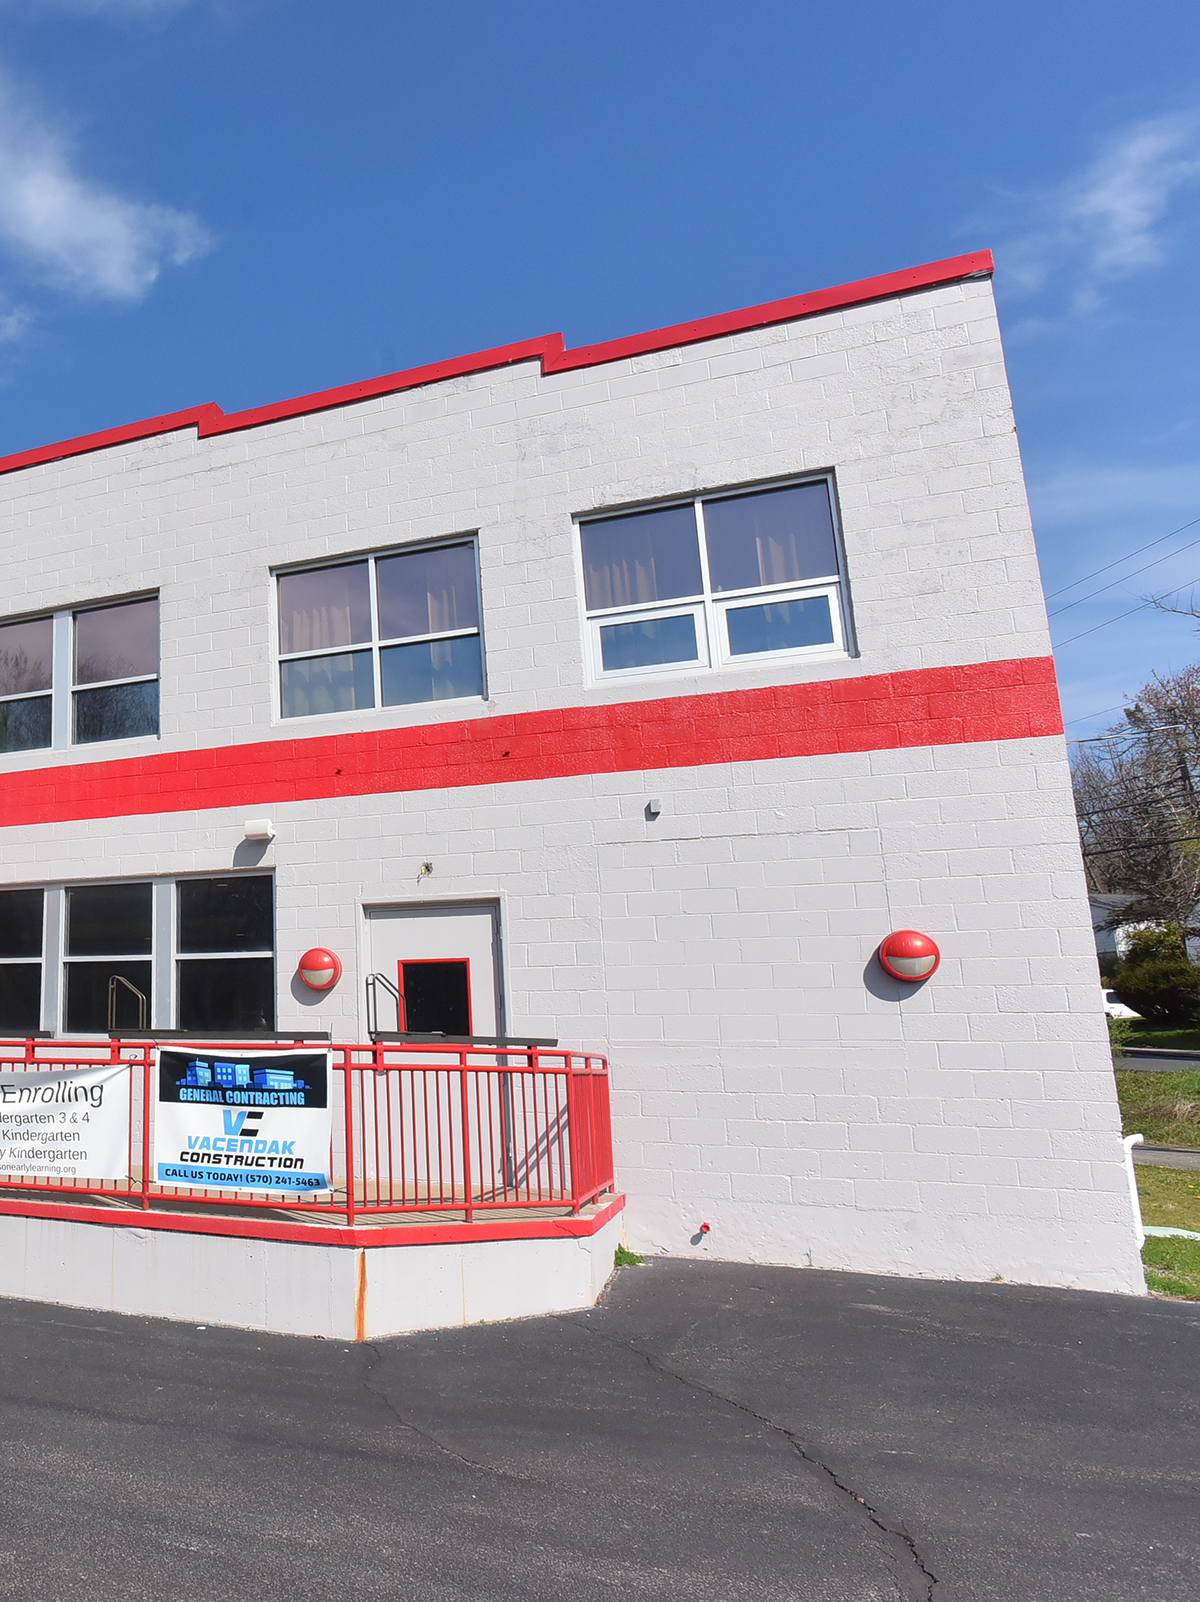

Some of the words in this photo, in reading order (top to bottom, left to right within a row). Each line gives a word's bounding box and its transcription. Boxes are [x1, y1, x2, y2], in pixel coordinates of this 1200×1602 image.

[0, 1080, 104, 1108] Enrolling
[179, 1087, 225, 1103] GENERAL
[225, 1090, 305, 1106] CONTRACTING
[59, 1111, 67, 1124] 3
[69, 1111, 78, 1124] &
[81, 1111, 90, 1124] 4
[2, 1128, 80, 1144] Kindergarten
[187, 1135, 296, 1155] VACENDAK
[8, 1146, 87, 1162] Kindergarten
[180, 1151, 304, 1169] CONSTRUCTION
[165, 1168, 189, 1178] CALL
[190, 1170, 204, 1180] US
[206, 1171, 243, 1182] TODAY!
[245, 1173, 272, 1185] (570)
[274, 1175, 321, 1187] 241-5463
